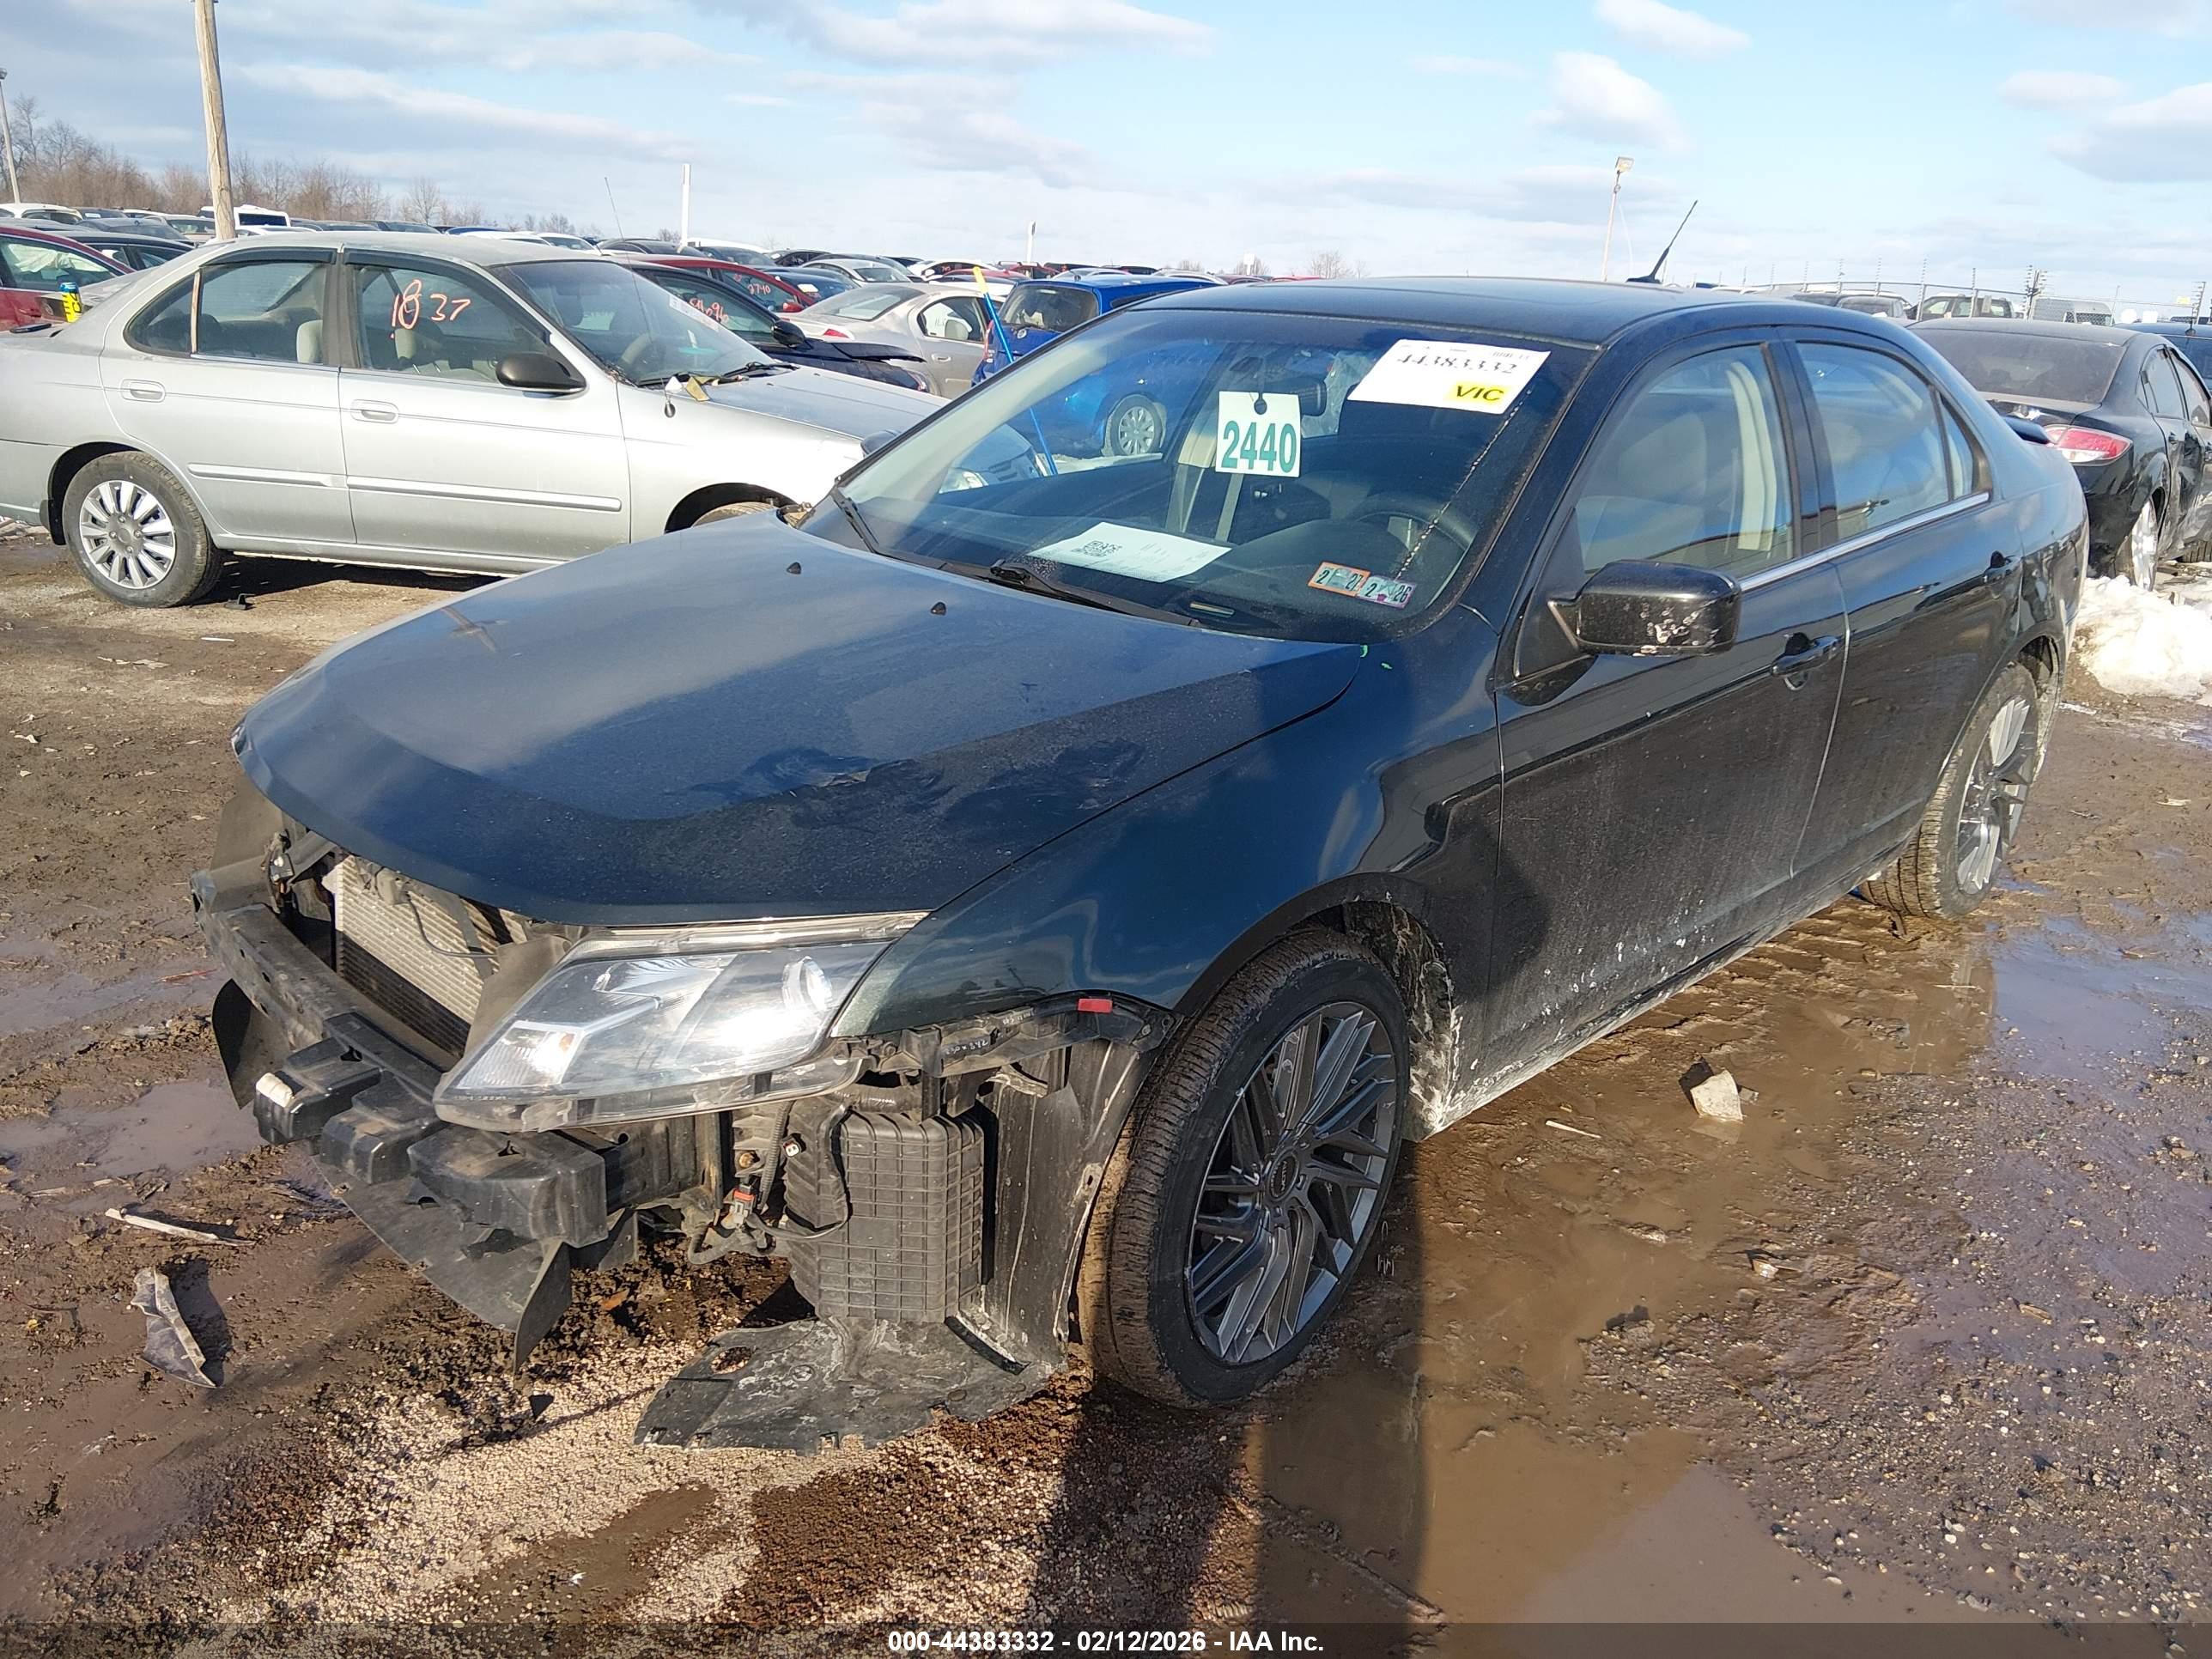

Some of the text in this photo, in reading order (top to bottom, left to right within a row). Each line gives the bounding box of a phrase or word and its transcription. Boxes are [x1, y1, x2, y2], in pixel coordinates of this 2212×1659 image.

[1456, 385, 1504, 402] VIC
[1221, 420, 1297, 474] 2440
[1316, 569, 1331, 585] 2
[1364, 582, 1378, 598] 2
